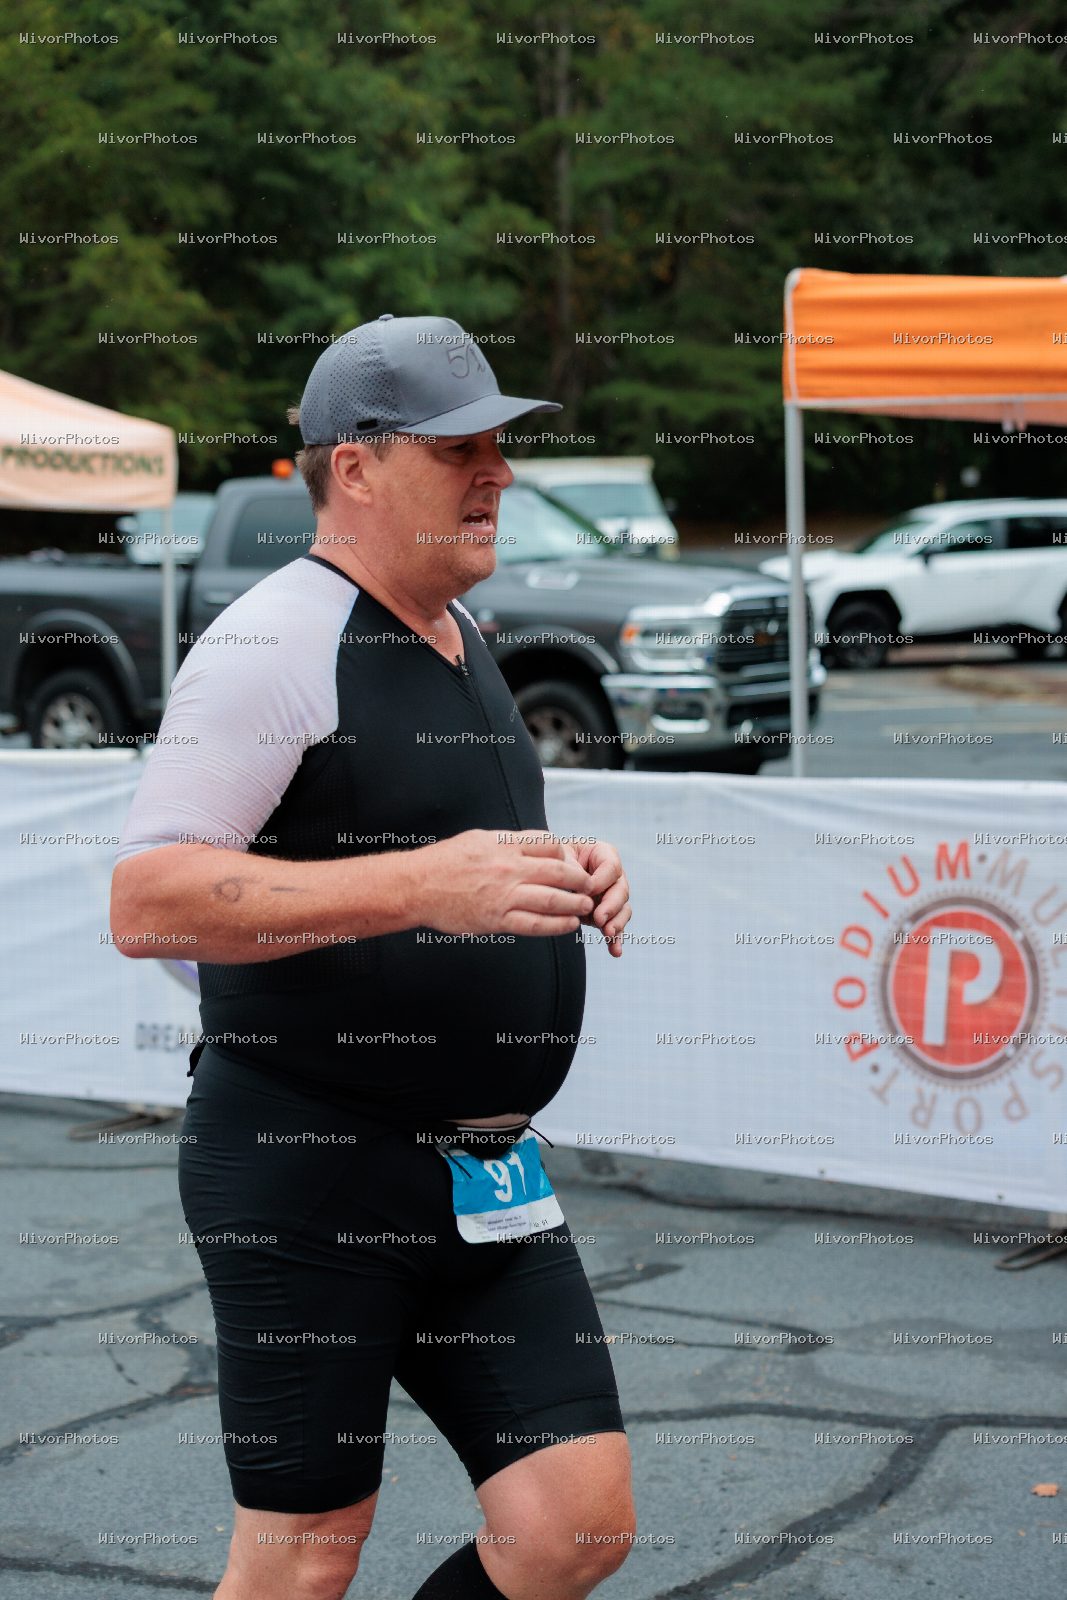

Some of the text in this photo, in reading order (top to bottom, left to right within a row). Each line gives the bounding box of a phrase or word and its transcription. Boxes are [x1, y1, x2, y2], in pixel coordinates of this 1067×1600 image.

[1, 446, 166, 477] PRODUCTIONS
[833, 840, 972, 1062] PODIUM
[483, 1151, 528, 1203] 91
